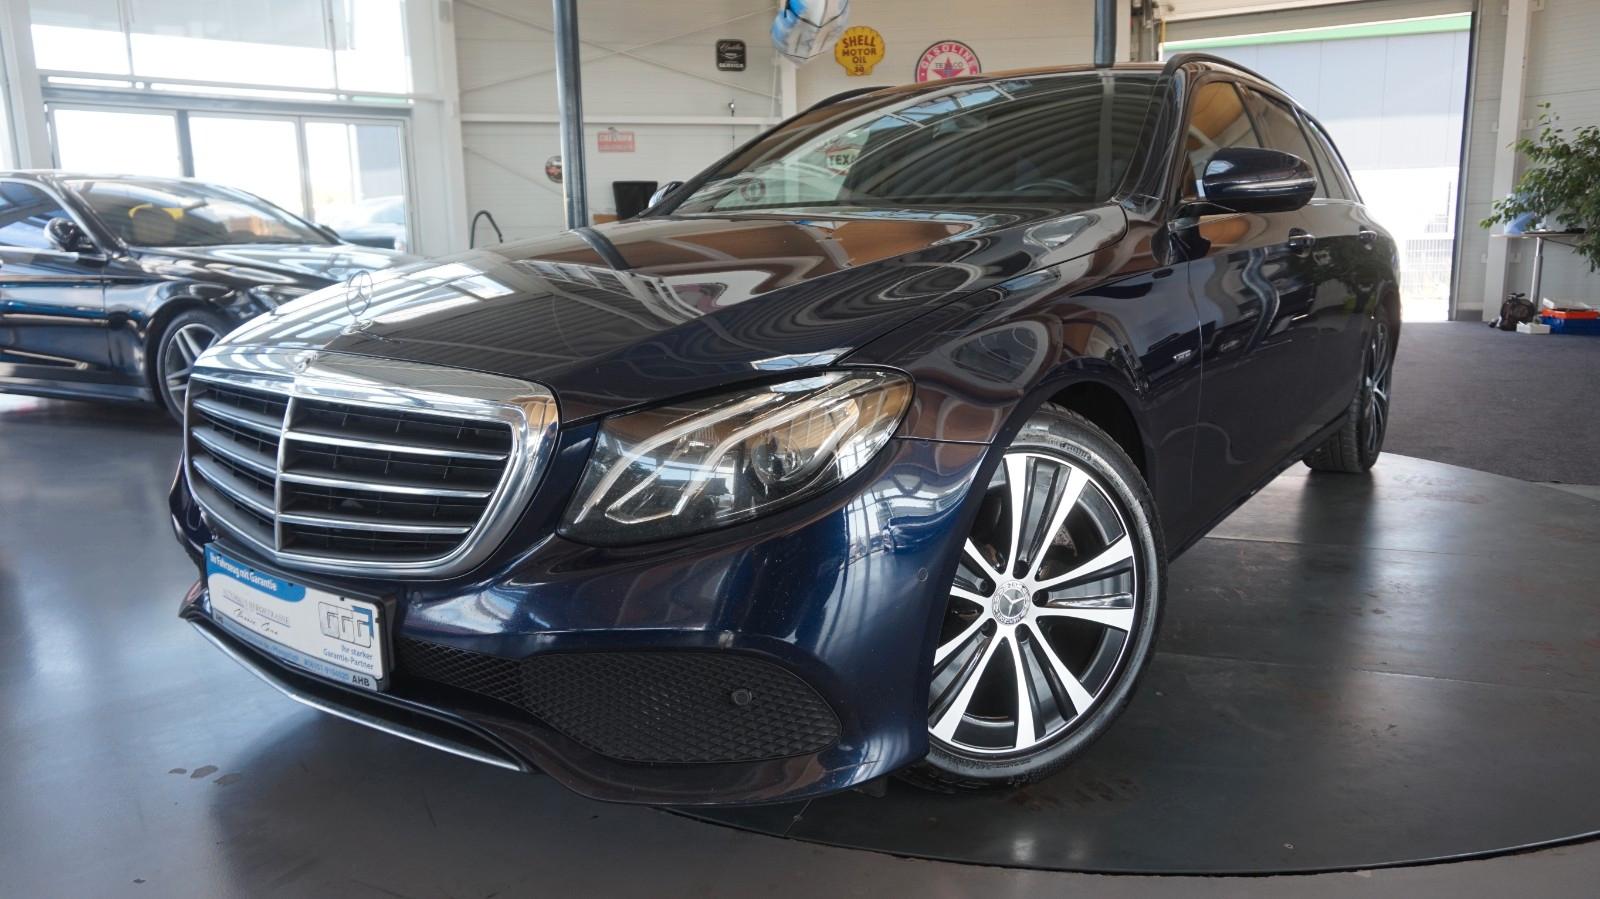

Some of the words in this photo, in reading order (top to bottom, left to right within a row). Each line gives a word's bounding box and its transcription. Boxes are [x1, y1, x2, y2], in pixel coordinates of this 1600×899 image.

[842, 35, 876, 48] SHELL
[842, 48, 877, 56] MOTOR
[921, 44, 978, 69] GASOLINE
[852, 56, 867, 64] OIL
[216, 555, 240, 578] Fahrzeug
[249, 572, 277, 591] Garantie
[323, 648, 374, 670] Garantie-Partner
[351, 648, 373, 660] starker
[352, 675, 370, 687] AHB
